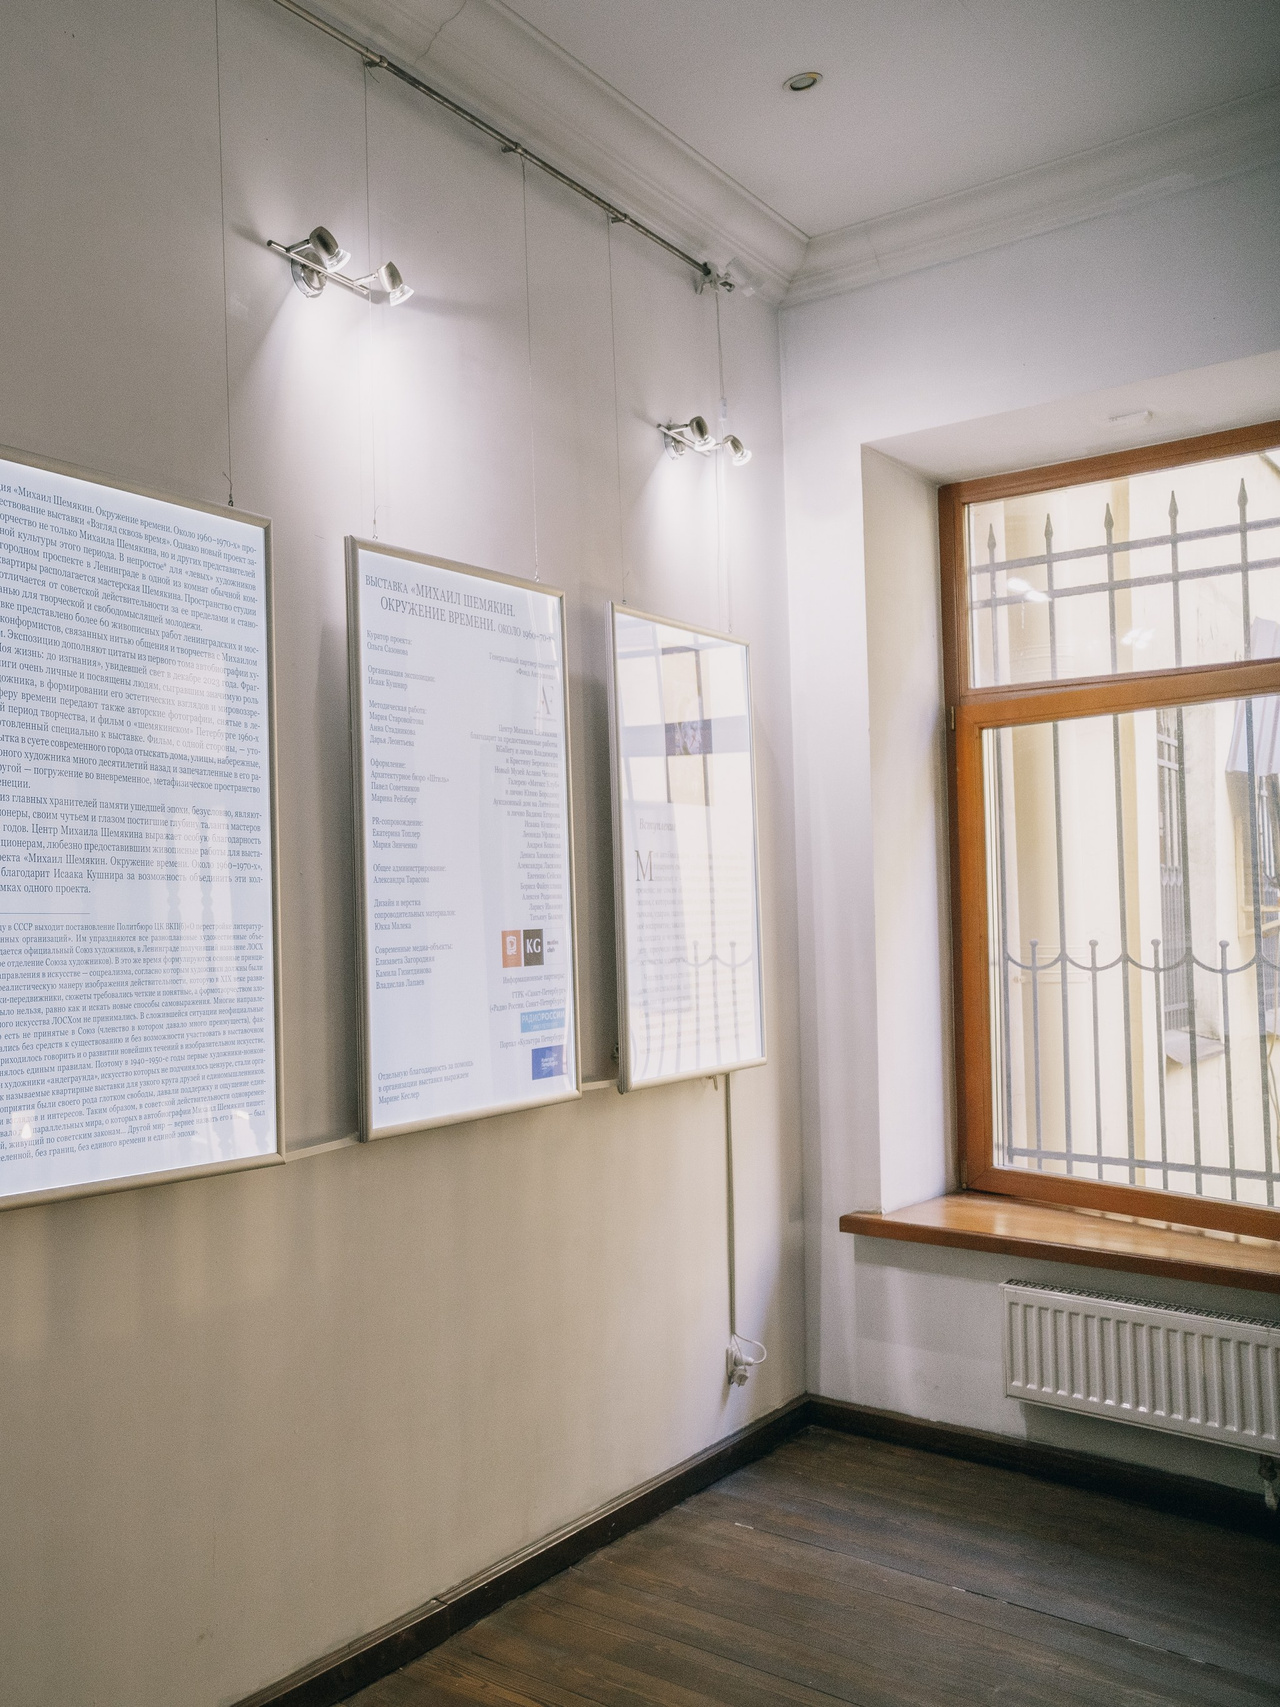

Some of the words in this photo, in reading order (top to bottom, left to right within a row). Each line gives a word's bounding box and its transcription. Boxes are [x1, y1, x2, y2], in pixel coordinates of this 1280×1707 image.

[14, 486, 52, 503] «Михаил
[53, 495, 94, 514] Шемякин.
[95, 506, 139, 525] Окружение
[140, 519, 172, 533] времени.
[173, 525, 196, 539] Около
[242, 544, 257, 554] про-
[47, 510, 85, 525] выставки
[86, 518, 118, 534] «Взгляд
[118, 527, 143, 539] сквозь
[144, 533, 172, 546] время».
[173, 538, 200, 553] Однако
[200, 547, 222, 558] новый
[223, 552, 246, 564] проект
[247, 558, 257, 566] за-
[42, 551, 84, 567] проспекте
[93, 560, 140, 579] Ленинграде
[148, 575, 171, 586] одной
[173, 580, 182, 588] из
[183, 582, 209, 594] комнат
[210, 586, 241, 600] обычной
[243, 595, 258, 604] ком-
[365, 574, 408, 594] ВЫСТАВКА
[411, 583, 461, 605] «МИХАИЛ
[463, 594, 515, 617] ШЕМЯКИН.
[22, 590, 38, 600] для
[39, 593, 85, 609] творческой
[94, 604, 163, 624] свободомыслящей
[165, 618, 202, 631] молодежи.
[380, 596, 446, 622] ОКРУЖЕНИЕ
[448, 610, 496, 632] ВРЕМЕНИ.
[497, 623, 522, 637] ОКОЛО
[23, 885, 53, 893] одного
[55, 885, 91, 895] проекта.
[526, 938, 541, 954] KG
[15, 1019, 50, 1029] искусства
[51, 1015, 82, 1025] ЛОСХом
